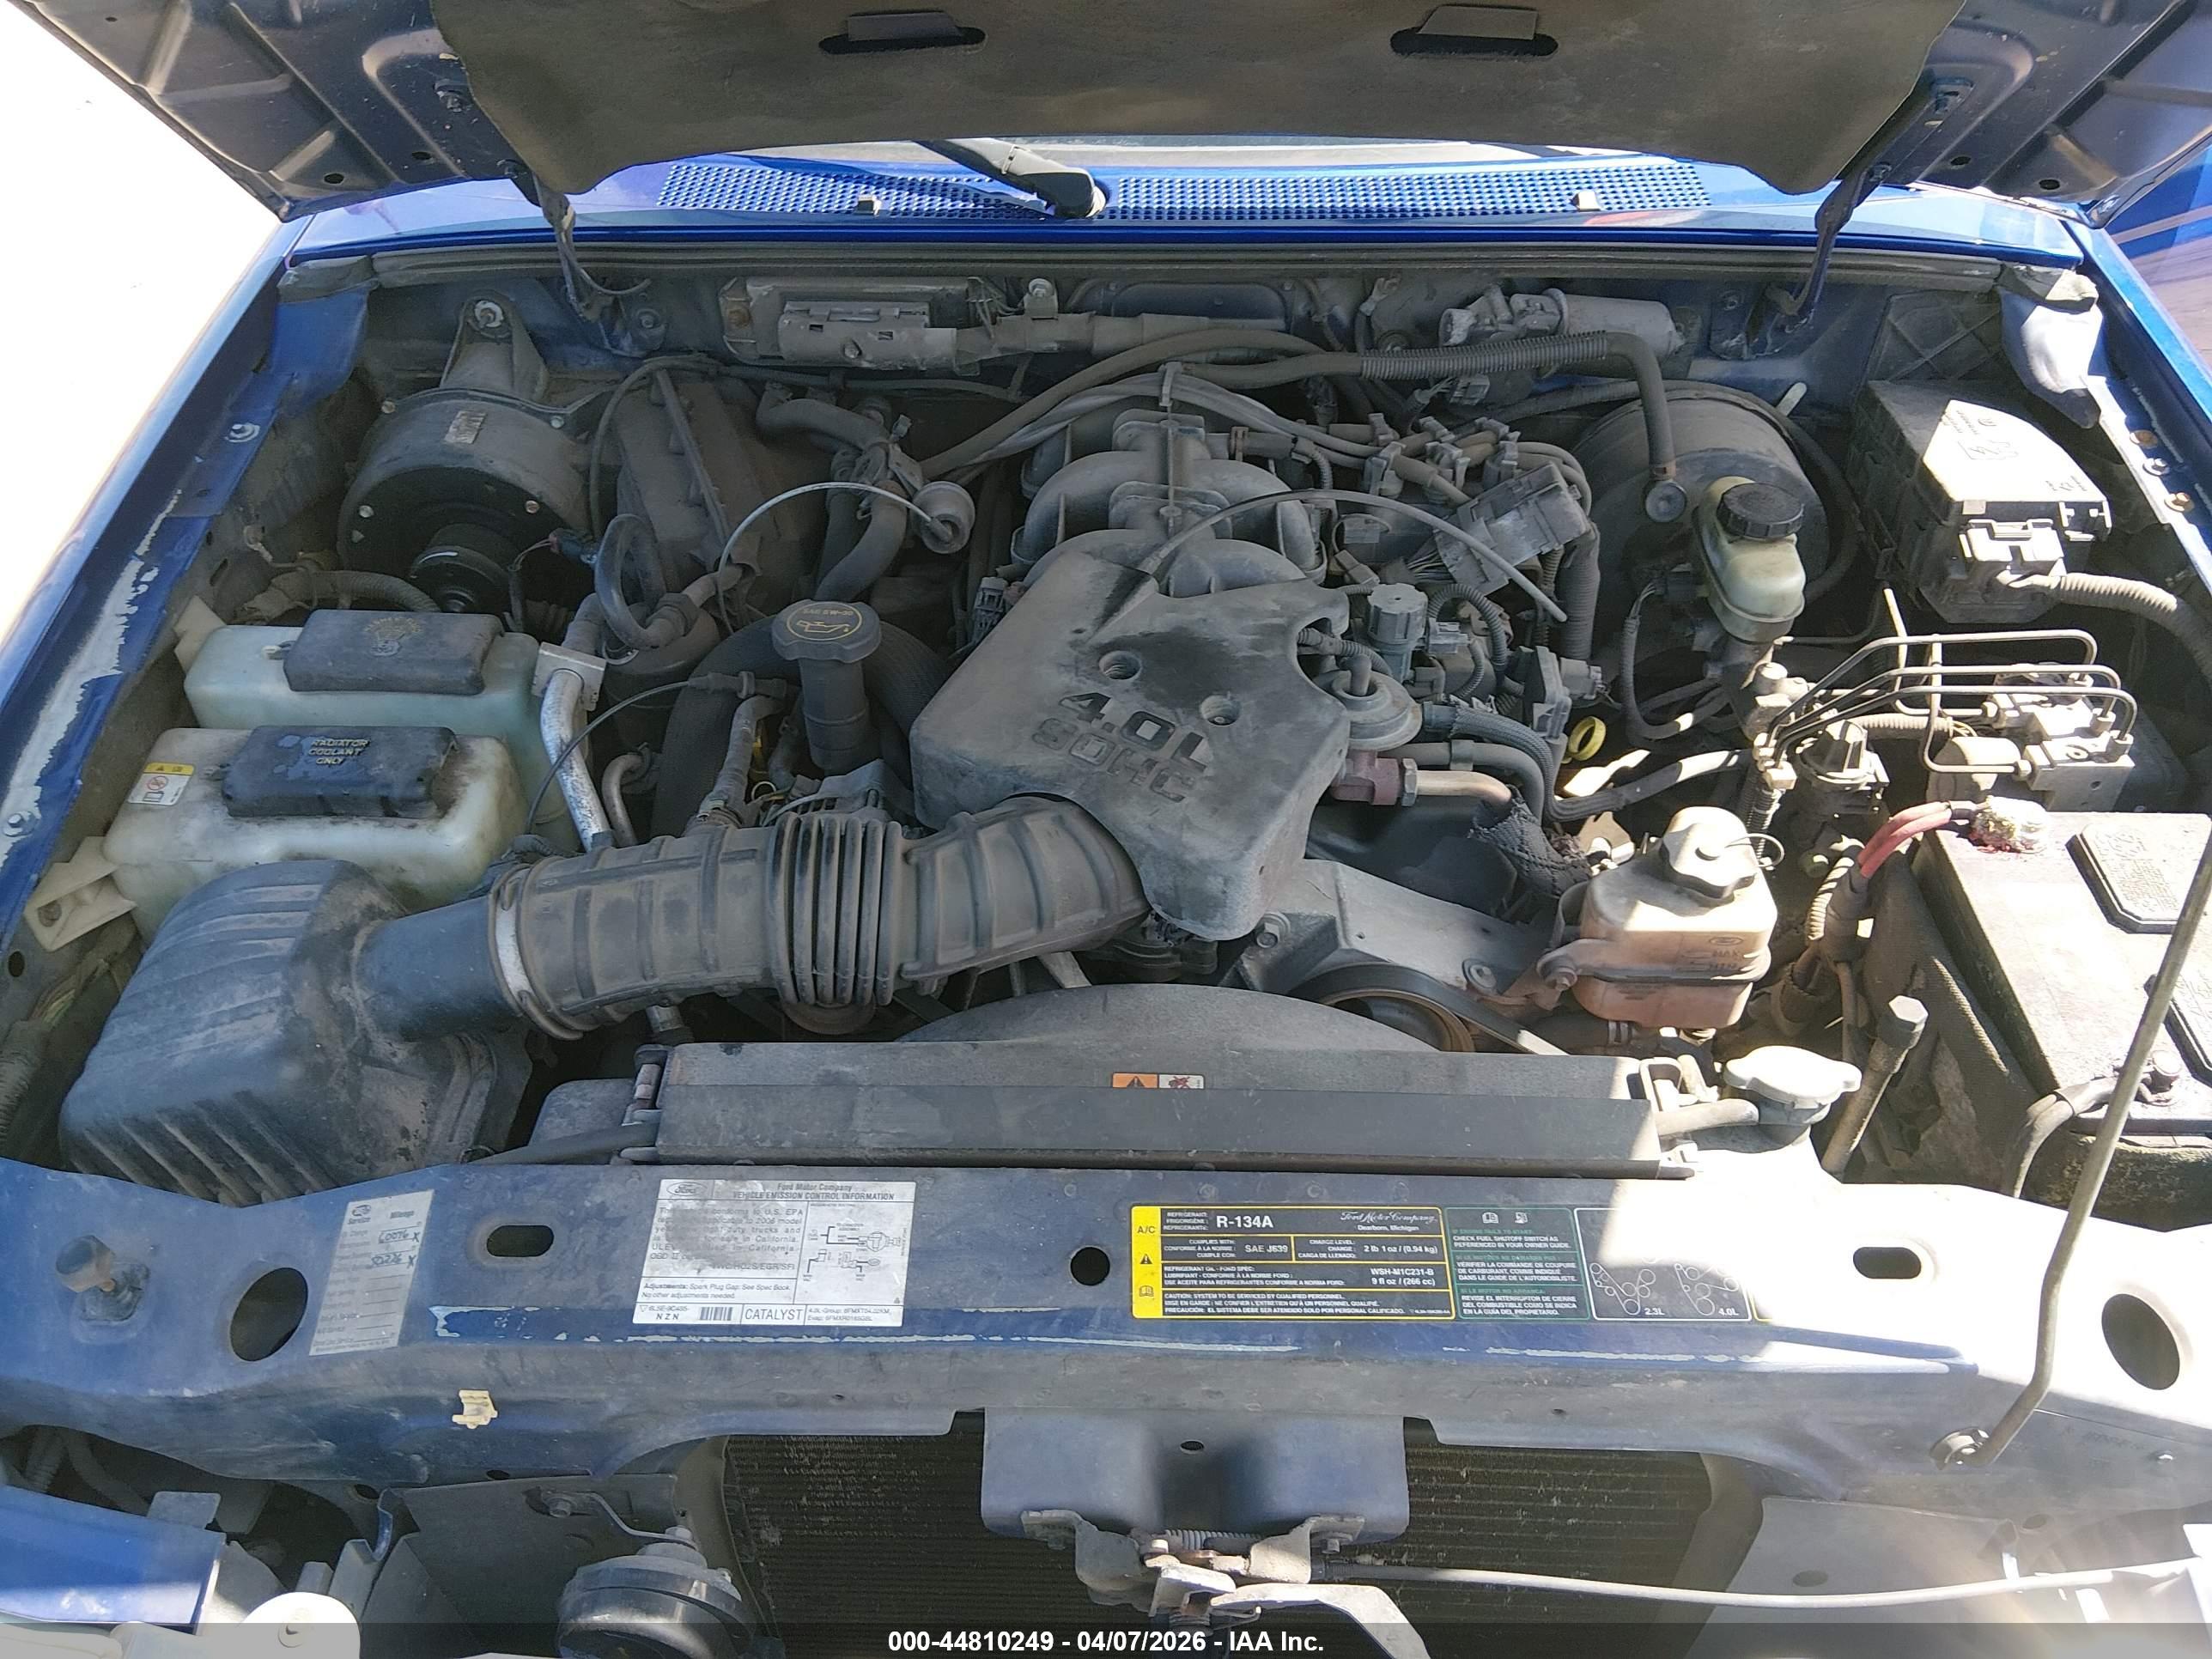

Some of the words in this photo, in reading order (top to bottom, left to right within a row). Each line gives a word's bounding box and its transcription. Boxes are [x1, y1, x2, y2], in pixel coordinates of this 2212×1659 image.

[1059, 692, 1207, 771] 4.0L
[1031, 718, 1196, 803] SOHC
[1217, 1216, 1273, 1228] R-134A
[1340, 1212, 1362, 1223] Ford
[1361, 1212, 1389, 1223] Motor
[1137, 1225, 1156, 1234] A/C
[744, 1309, 804, 1321] CATALYST
[1644, 1308, 1665, 1316] 2.3L
[1718, 1308, 1739, 1316] 4.0L
